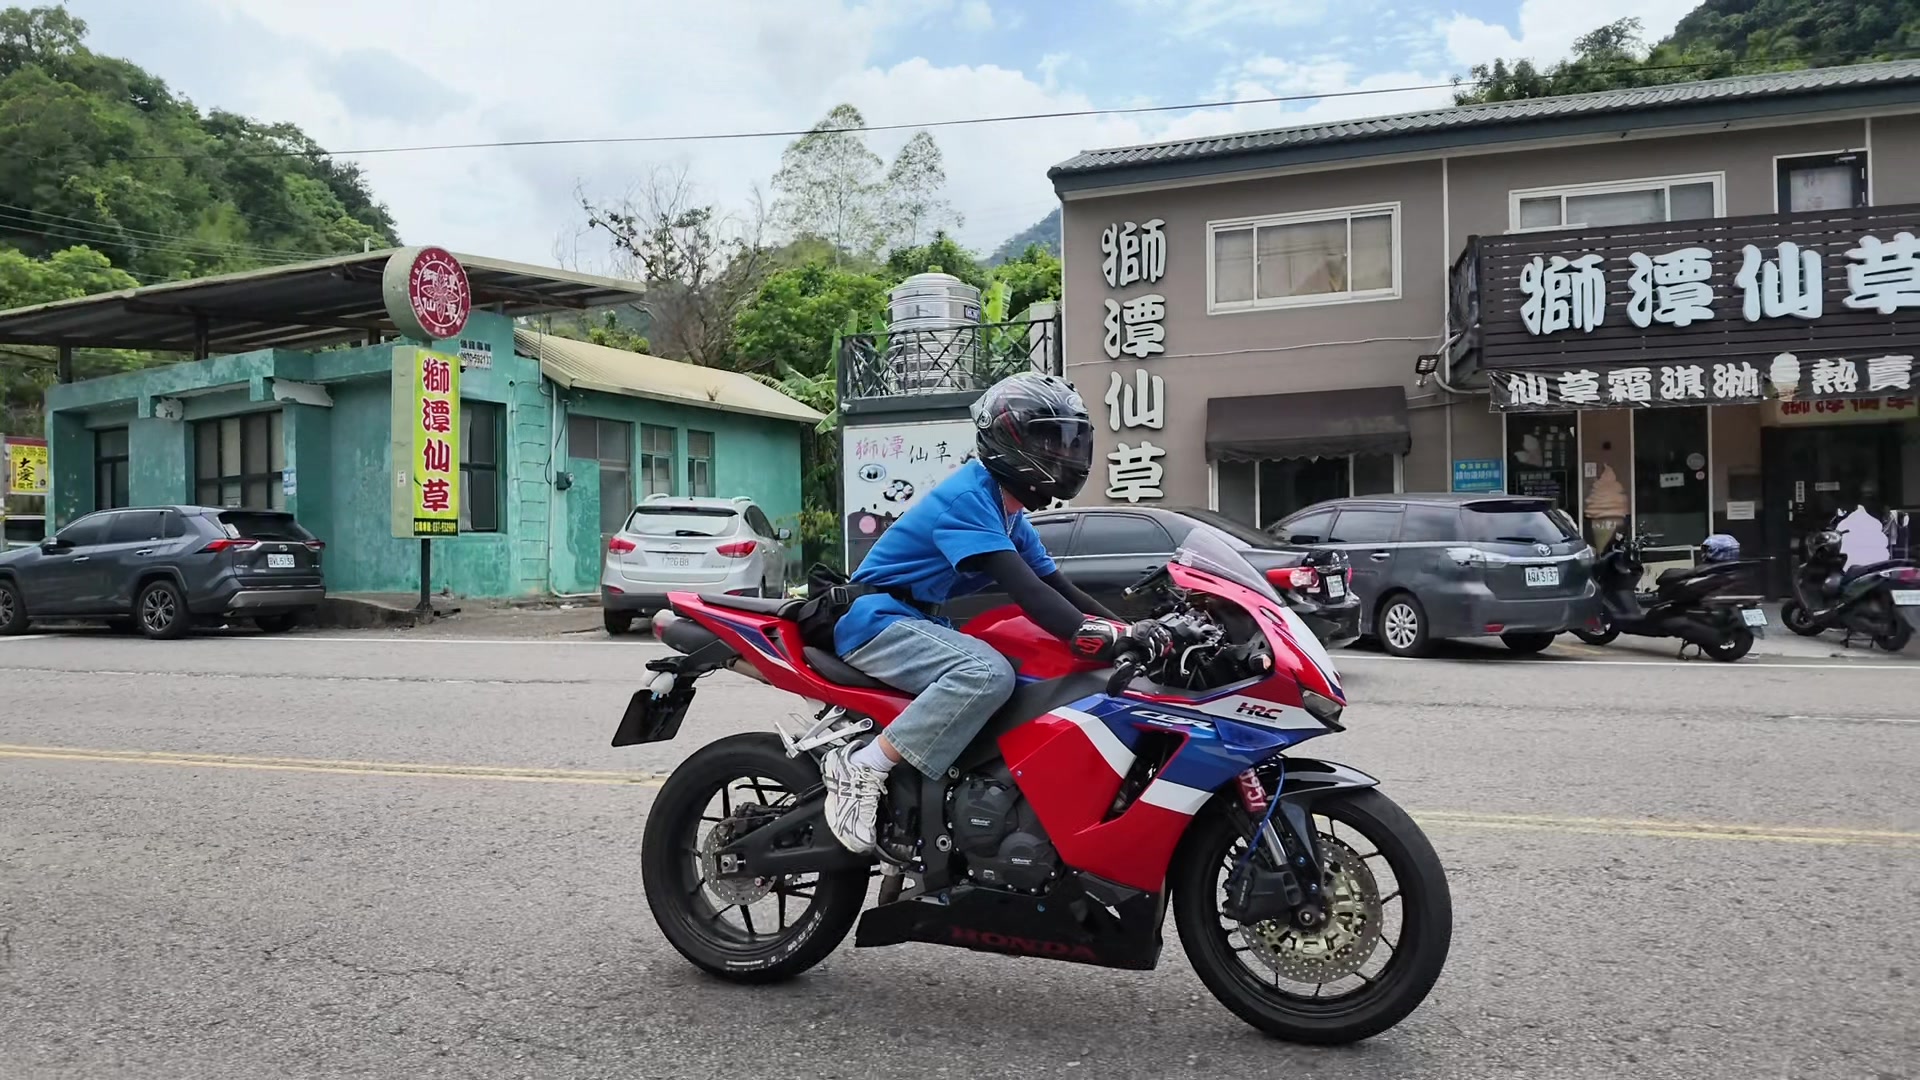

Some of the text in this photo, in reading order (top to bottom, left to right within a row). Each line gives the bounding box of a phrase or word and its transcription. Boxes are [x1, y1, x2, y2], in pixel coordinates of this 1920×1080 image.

[1519, 231, 1920, 336] 獅潭仙草
[1101, 219, 1166, 503] 獅潭仙草
[1508, 355, 1915, 407] 仙草霜淇淋 熱賣
[422, 357, 450, 513] 獅潭仙草
[1236, 702, 1283, 720] HRC
[950, 926, 1098, 960] HONDA
